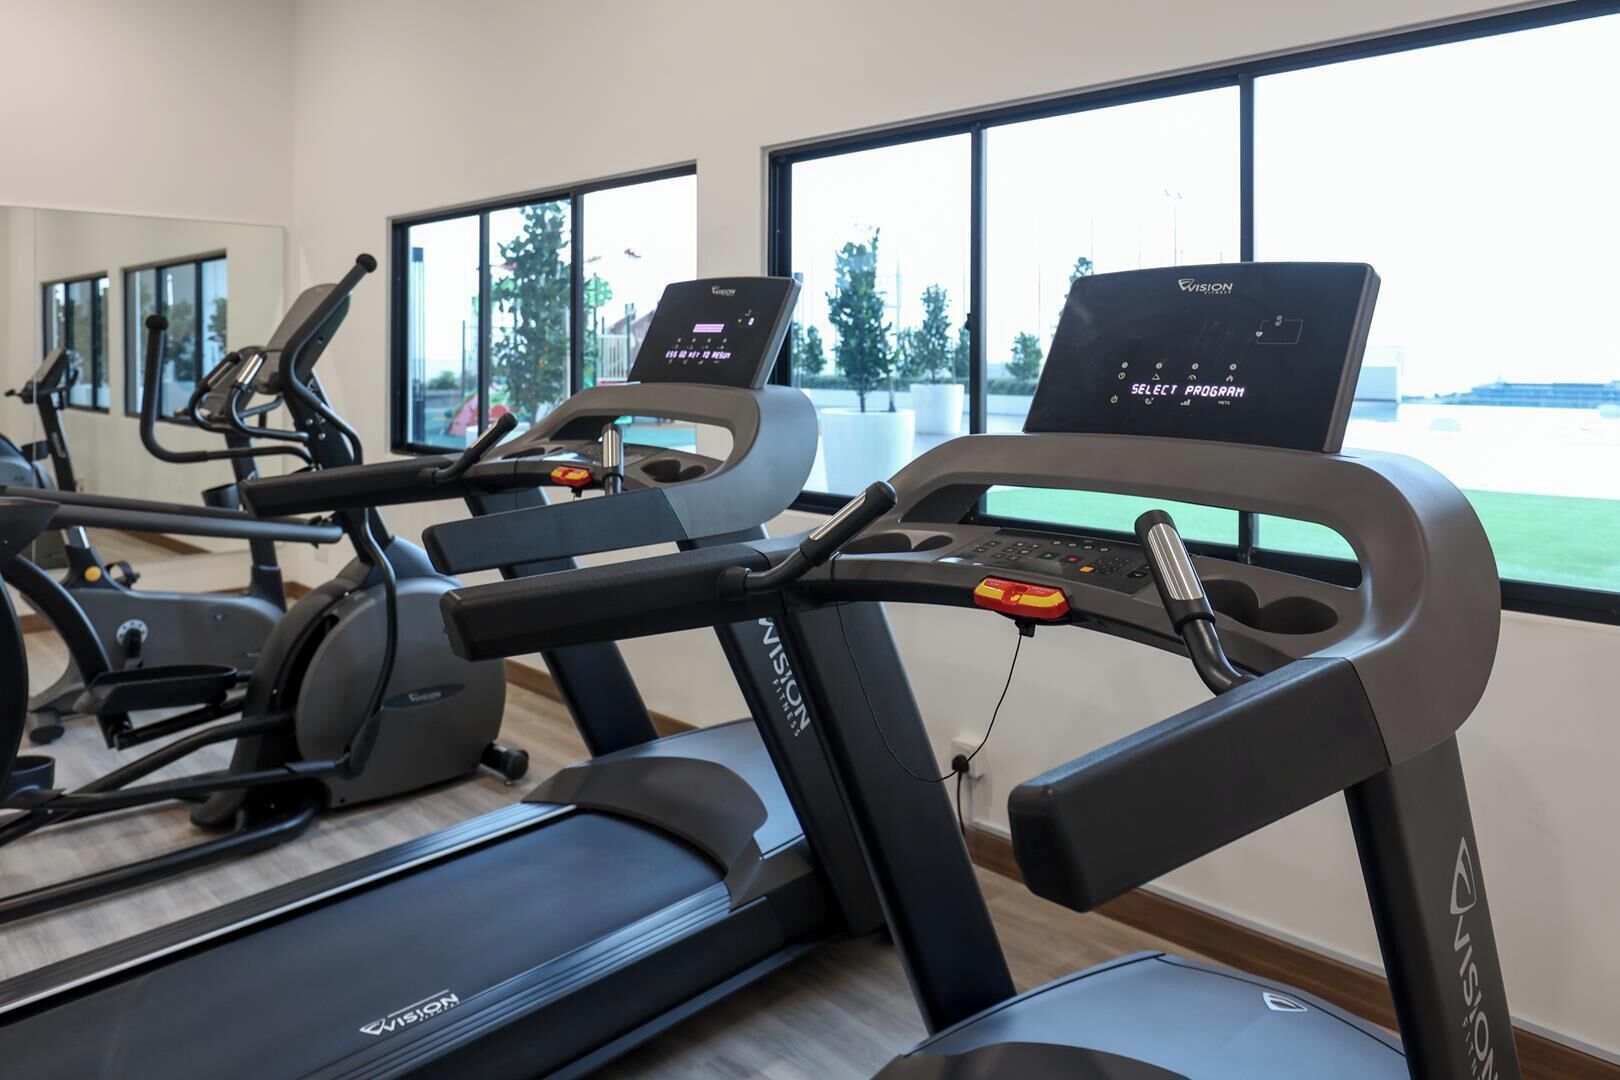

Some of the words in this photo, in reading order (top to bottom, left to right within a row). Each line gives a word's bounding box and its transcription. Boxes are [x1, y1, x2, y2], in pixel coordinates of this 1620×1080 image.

[1188, 283, 1233, 292] VISION
[1131, 383, 1178, 396] SELECT
[1184, 385, 1245, 398] PROGRAM
[763, 626, 811, 731] VISION
[772, 678, 801, 737] FITNESS
[383, 993, 460, 1032] VISION
[1454, 914, 1499, 1080] VISION
[1462, 1016, 1481, 1080] FITN
